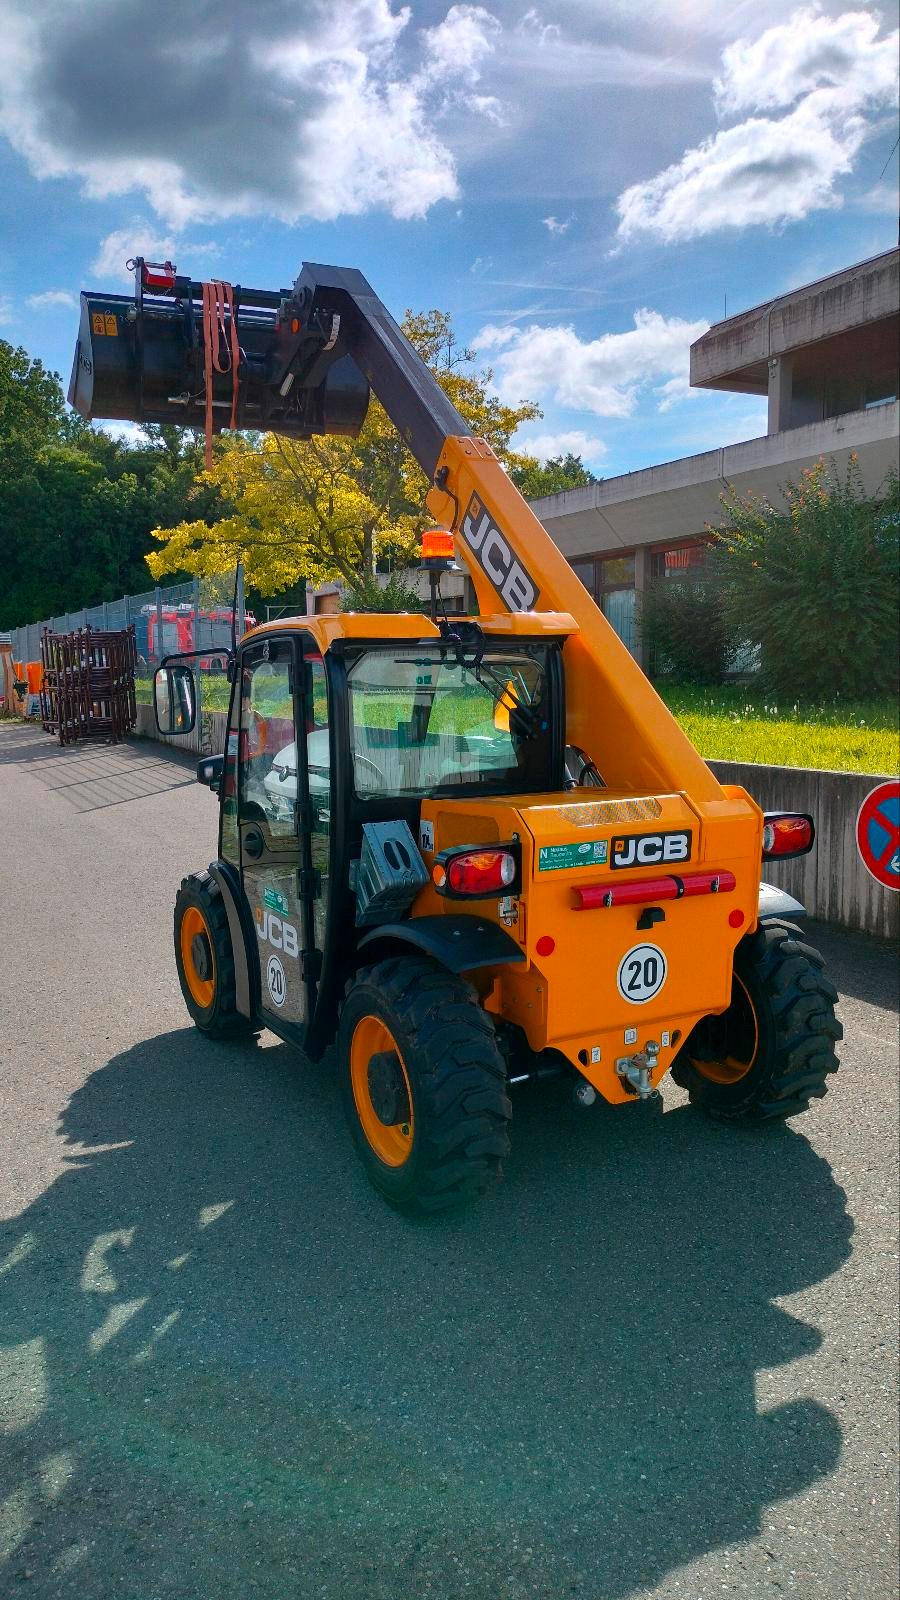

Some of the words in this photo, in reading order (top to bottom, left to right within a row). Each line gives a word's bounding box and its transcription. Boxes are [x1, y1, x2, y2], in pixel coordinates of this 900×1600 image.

[463, 513, 535, 613] JCB
[614, 834, 688, 866] JCB
[257, 911, 299, 959] JCB
[270, 966, 282, 996] 20
[628, 957, 658, 991] 20
